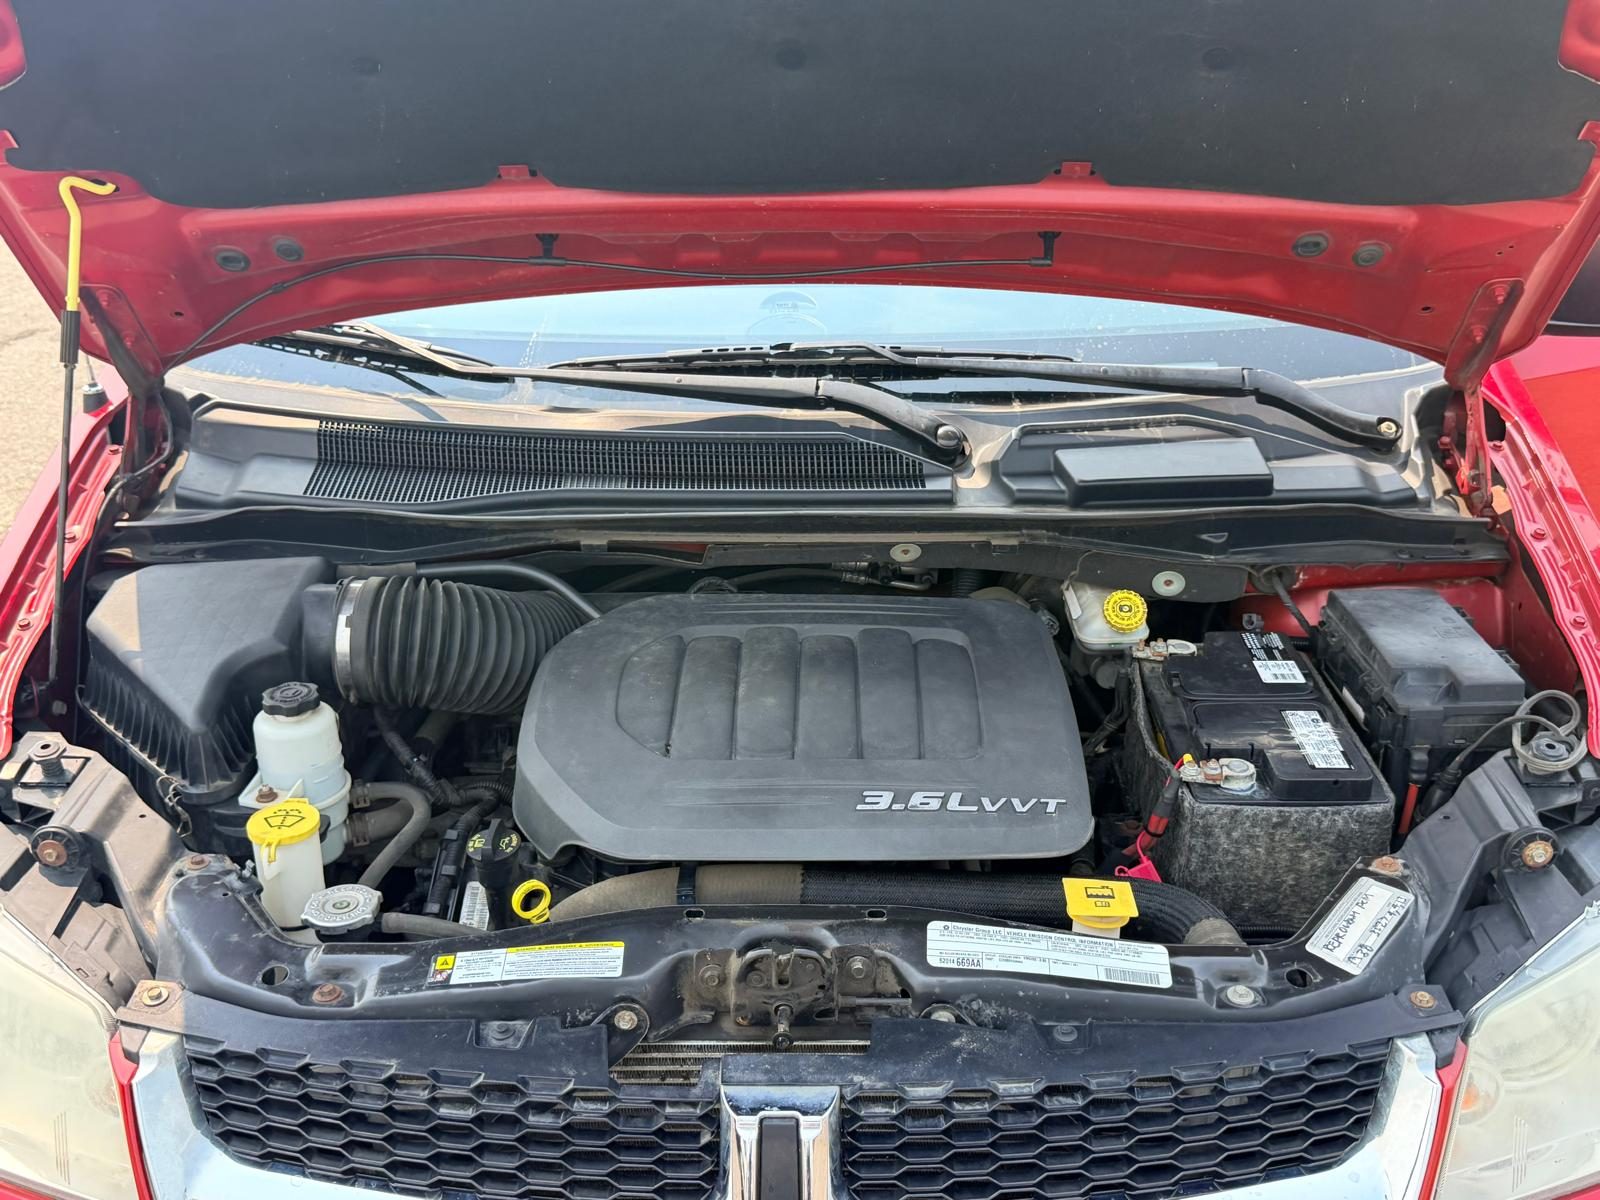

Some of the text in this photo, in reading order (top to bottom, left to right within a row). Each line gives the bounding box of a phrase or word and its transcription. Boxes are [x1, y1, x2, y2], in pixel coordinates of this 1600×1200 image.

[855, 790, 1067, 815] 3.6L VVT
[1078, 938, 1113, 946] INFORMATION
